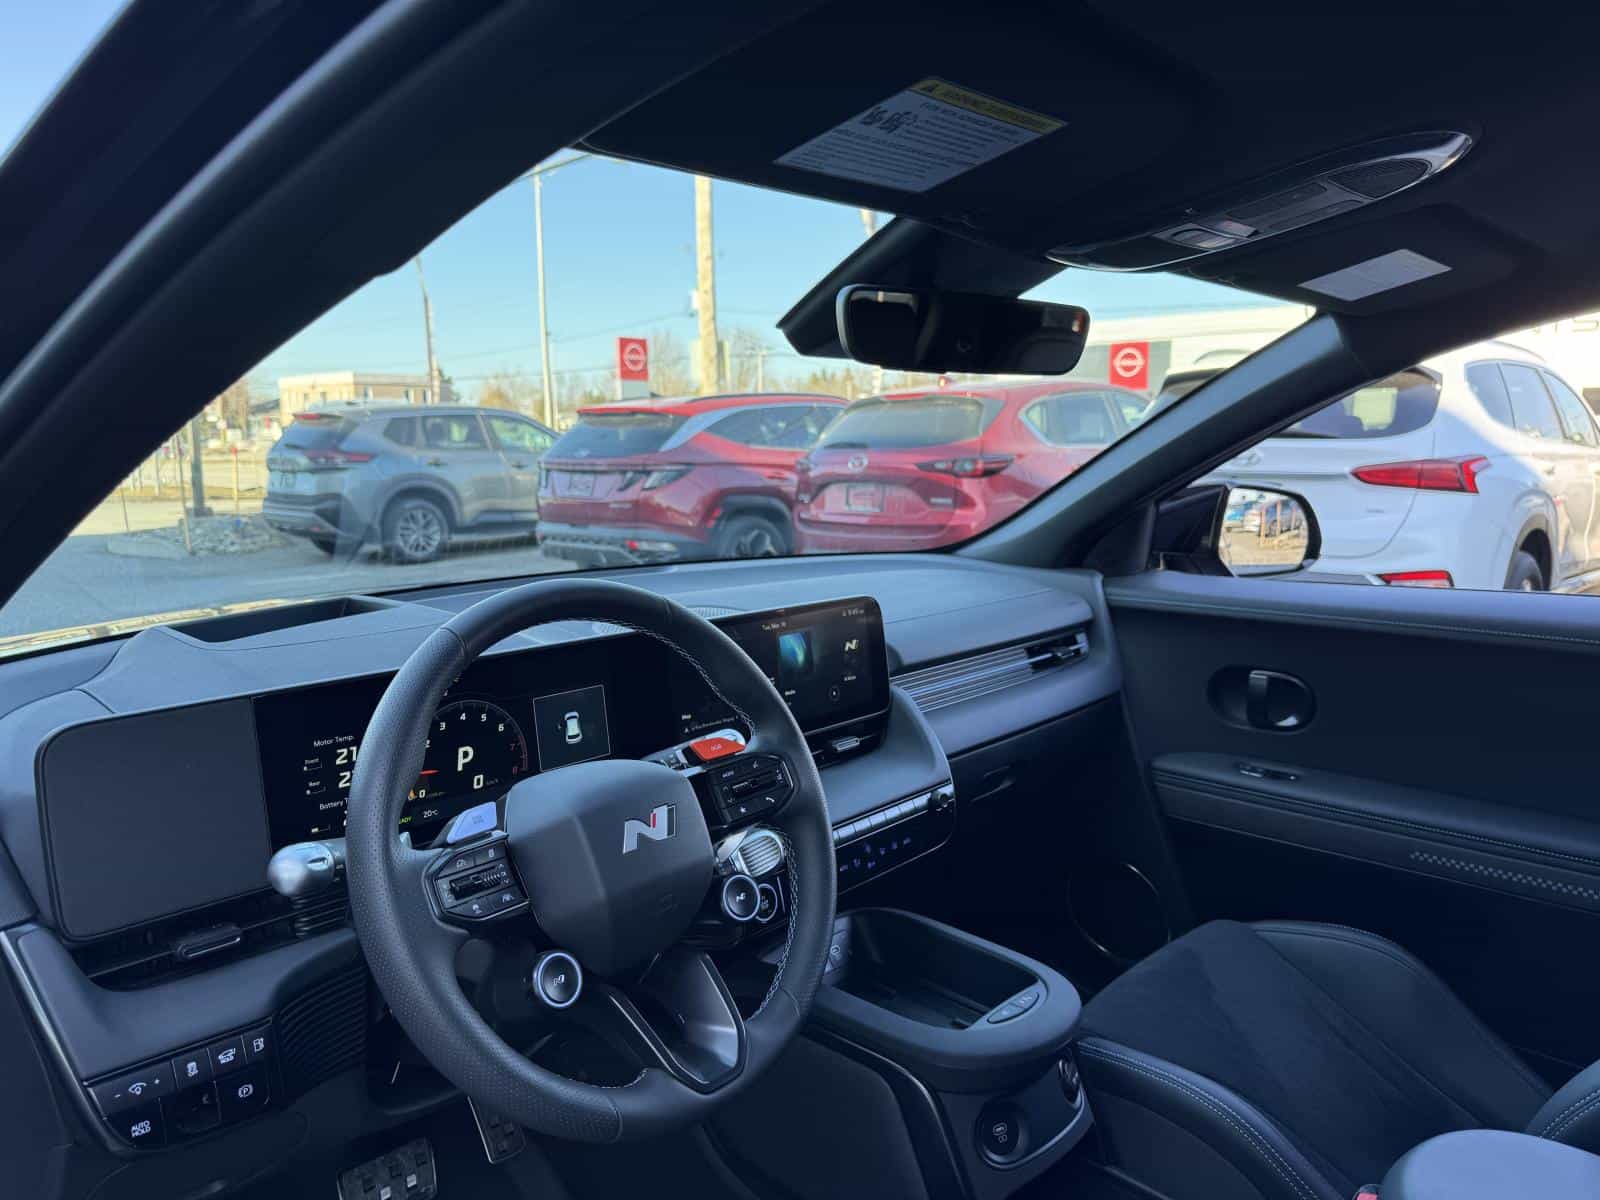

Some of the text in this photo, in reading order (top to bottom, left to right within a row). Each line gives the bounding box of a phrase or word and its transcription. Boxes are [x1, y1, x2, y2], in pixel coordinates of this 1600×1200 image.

[459, 711, 467, 721] 4
[480, 713, 488, 722] 5
[439, 721, 447, 732] 3
[497, 722, 505, 732] 6
[313, 738, 335, 748] Motor
[456, 744, 475, 773] P
[337, 771, 354, 789] 2
[472, 773, 485, 790] 0
[417, 788, 427, 799] 0
[319, 799, 345, 812] Battery
[622, 802, 677, 854] N
[131, 1119, 151, 1131] AUTO
[131, 1126, 152, 1138] HOLD
